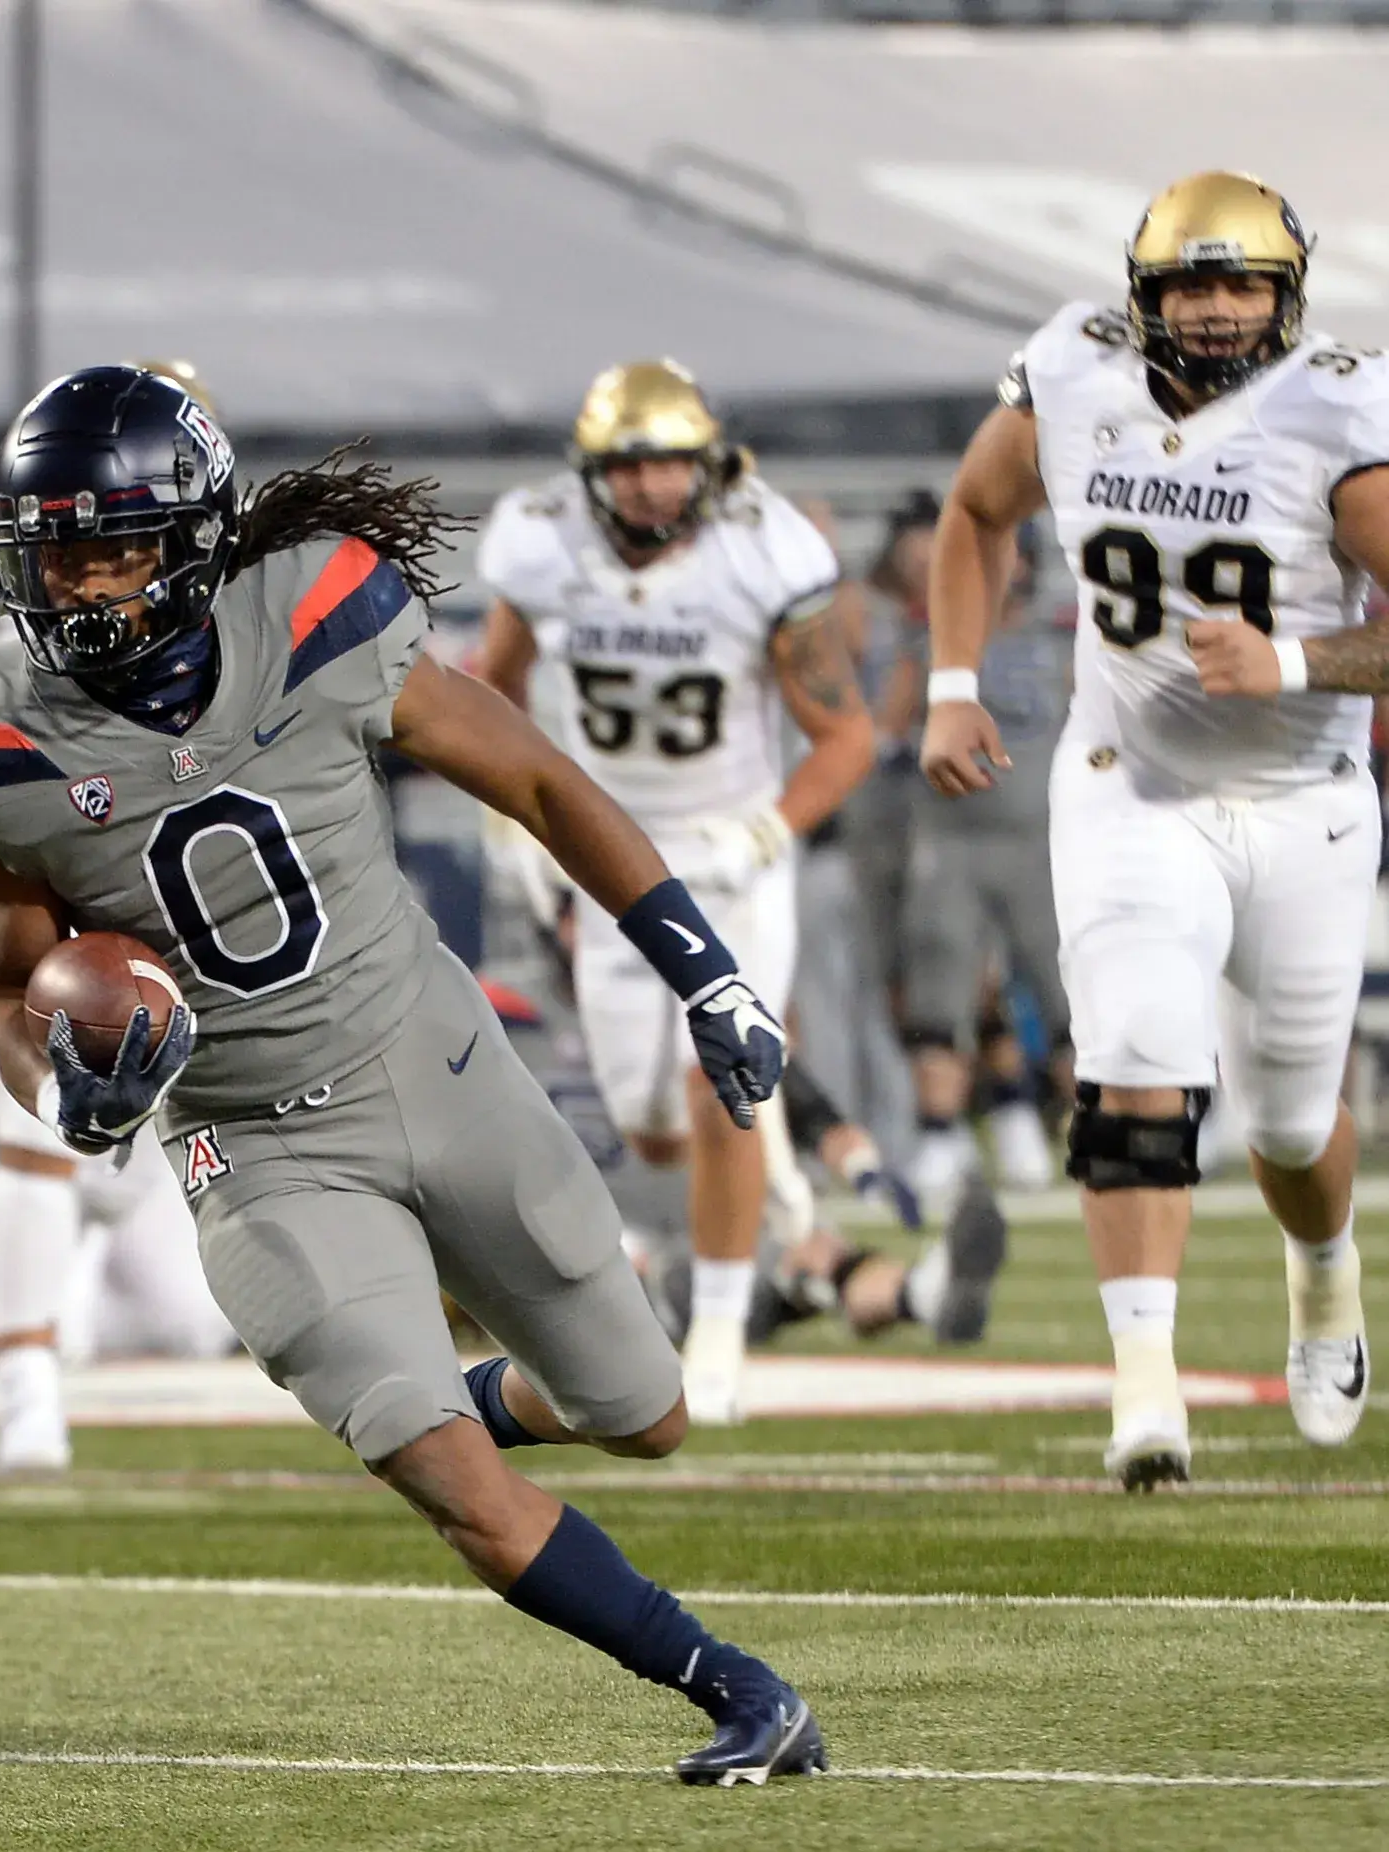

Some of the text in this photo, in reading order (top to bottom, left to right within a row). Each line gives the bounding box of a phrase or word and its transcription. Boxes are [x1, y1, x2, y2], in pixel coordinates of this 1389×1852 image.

[1084, 471, 1251, 525] COLORADO
[1081, 524, 1276, 649] 99
[573, 663, 728, 758] 53
[69, 775, 111, 812] PAC
[170, 745, 209, 783] A
[86, 794, 110, 818] 12
[141, 783, 330, 999] 0
[180, 1124, 235, 1200] A
